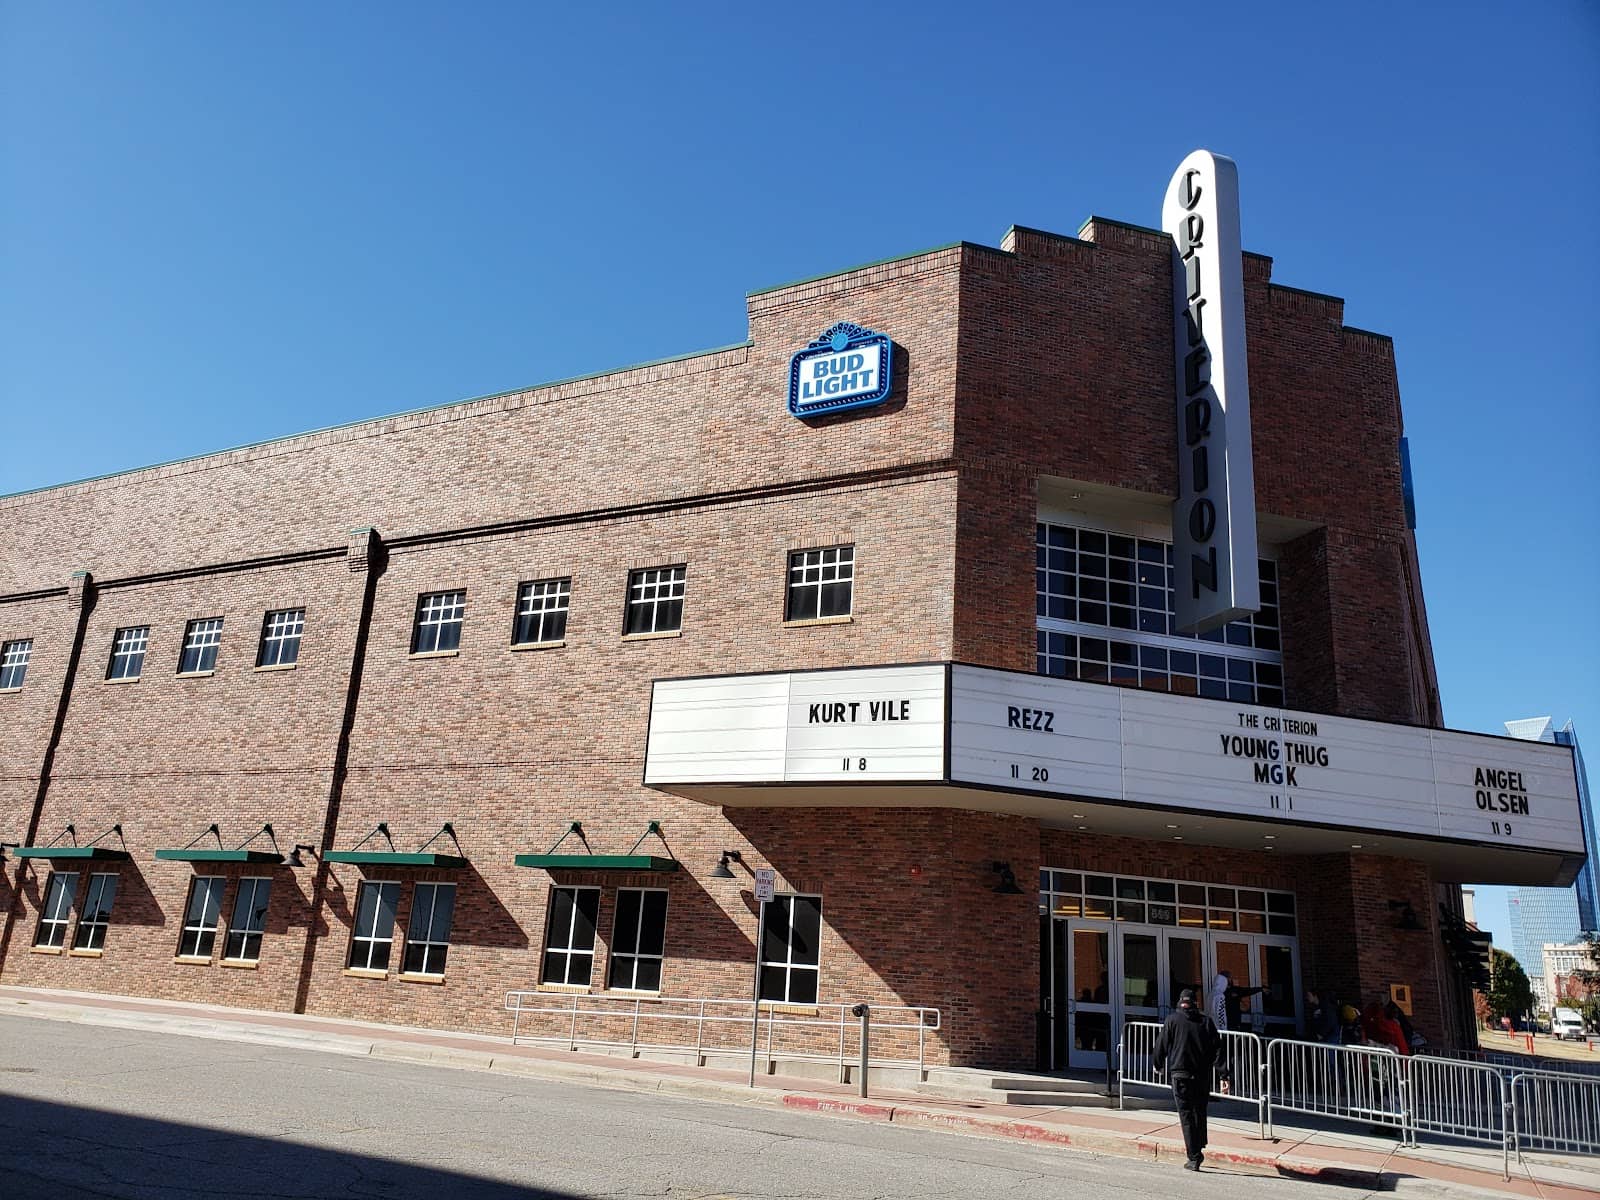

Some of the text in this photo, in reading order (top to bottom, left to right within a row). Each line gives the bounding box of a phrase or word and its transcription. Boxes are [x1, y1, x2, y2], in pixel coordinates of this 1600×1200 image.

[813, 353, 864, 379] BUD
[802, 369, 874, 399] LIGHT
[1178, 168, 1218, 600] CRITERION
[808, 700, 910, 724] KURT VILE
[1007, 705, 1055, 732] REZZ
[1238, 712, 1318, 736] THE CRITERION
[1219, 734, 1329, 767] YOUNG THUG
[858, 757, 867, 771] 8
[1032, 767, 1049, 782] 20
[1254, 762, 1298, 787] MGK
[1474, 767, 1527, 792] ANGEL
[1475, 790, 1530, 815] OLSEN
[1504, 822, 1512, 836] 9
[840, 1104, 859, 1113] LANE
